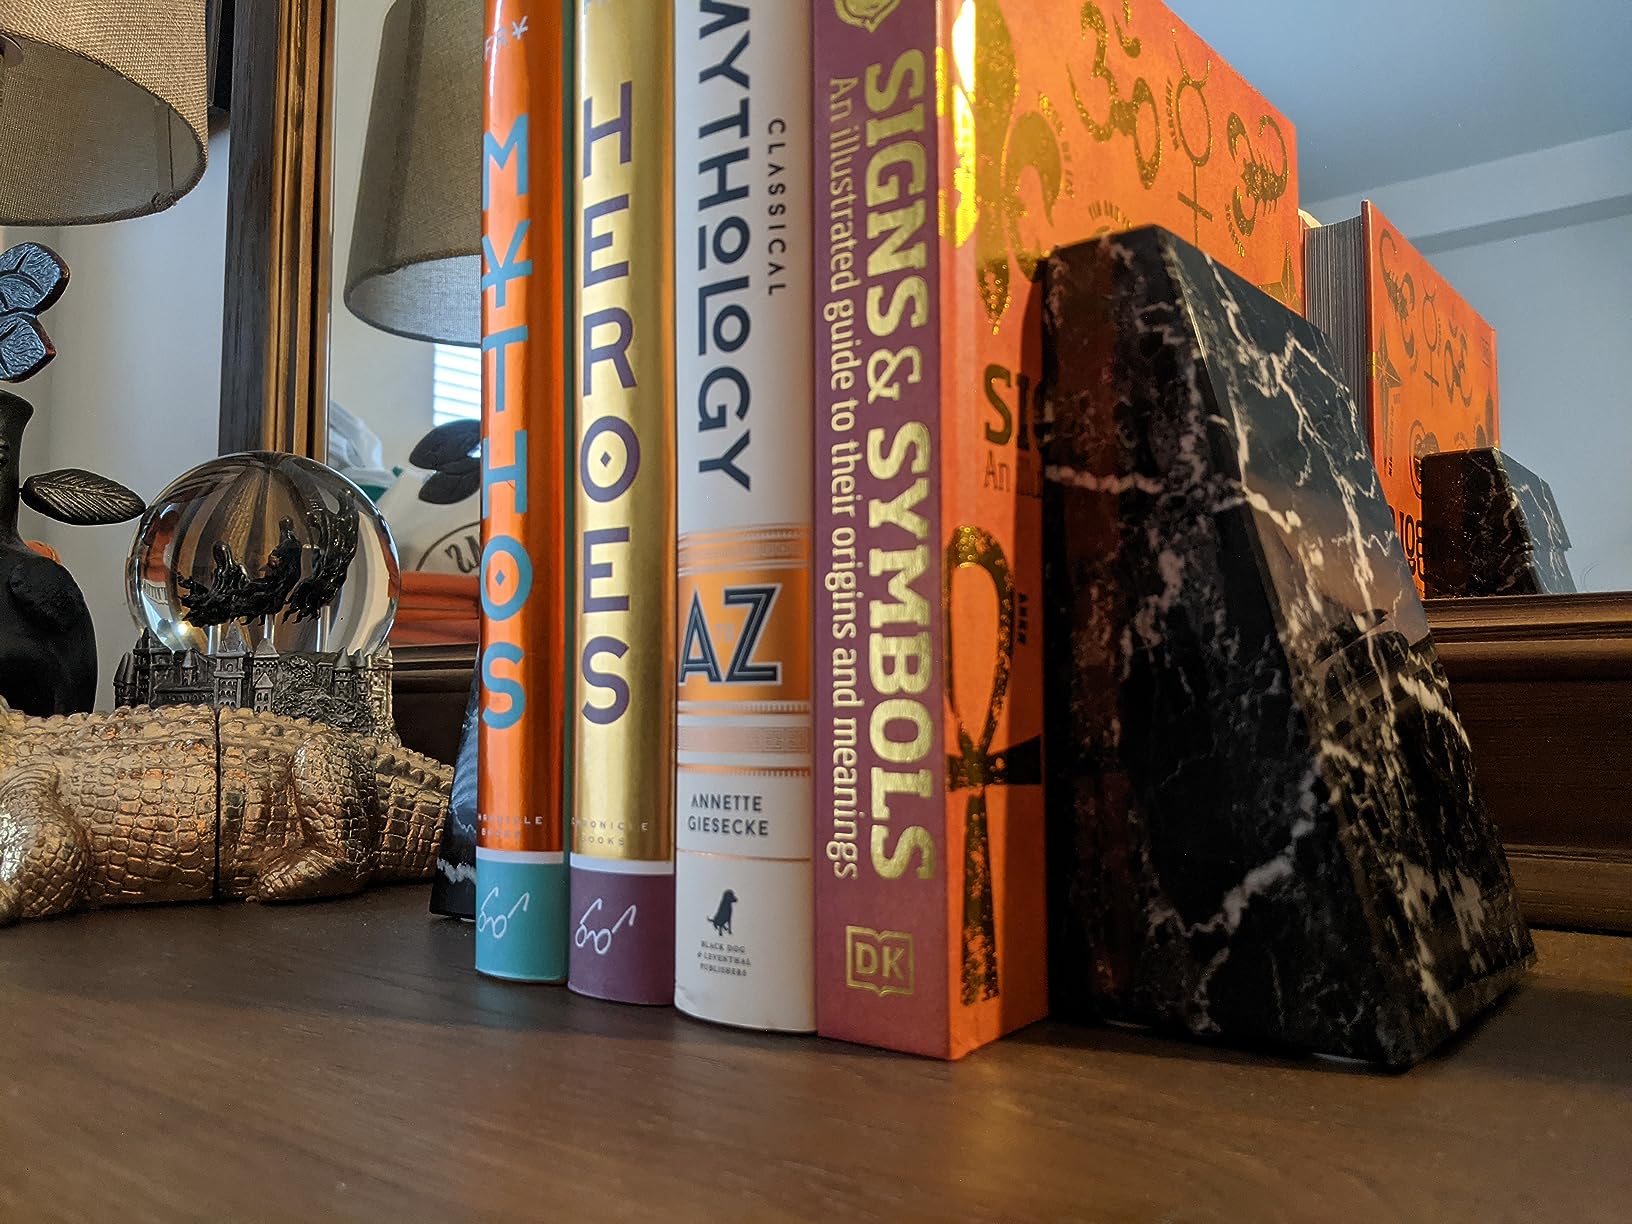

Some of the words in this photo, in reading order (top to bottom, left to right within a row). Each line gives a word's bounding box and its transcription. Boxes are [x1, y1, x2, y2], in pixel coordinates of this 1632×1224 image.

[829, 78, 858, 122] An
[767, 118, 787, 296] CLASSICAL
[829, 125, 862, 293] illustrated
[864, 48, 930, 336] SIGNS
[824, 298, 862, 391] guide
[866, 345, 924, 405] &
[480, 113, 533, 730] MYTHOS
[581, 81, 641, 725] HEROES
[830, 398, 859, 432] to
[830, 439, 863, 518] their
[825, 527, 863, 641] origins
[832, 646, 865, 709] and
[867, 420, 937, 881] SYMBOLS
[688, 815, 769, 836] GIESECKE
[691, 793, 763, 812] ANNETTE
[826, 717, 865, 880] meanings
[856, 942, 904, 979] DK
